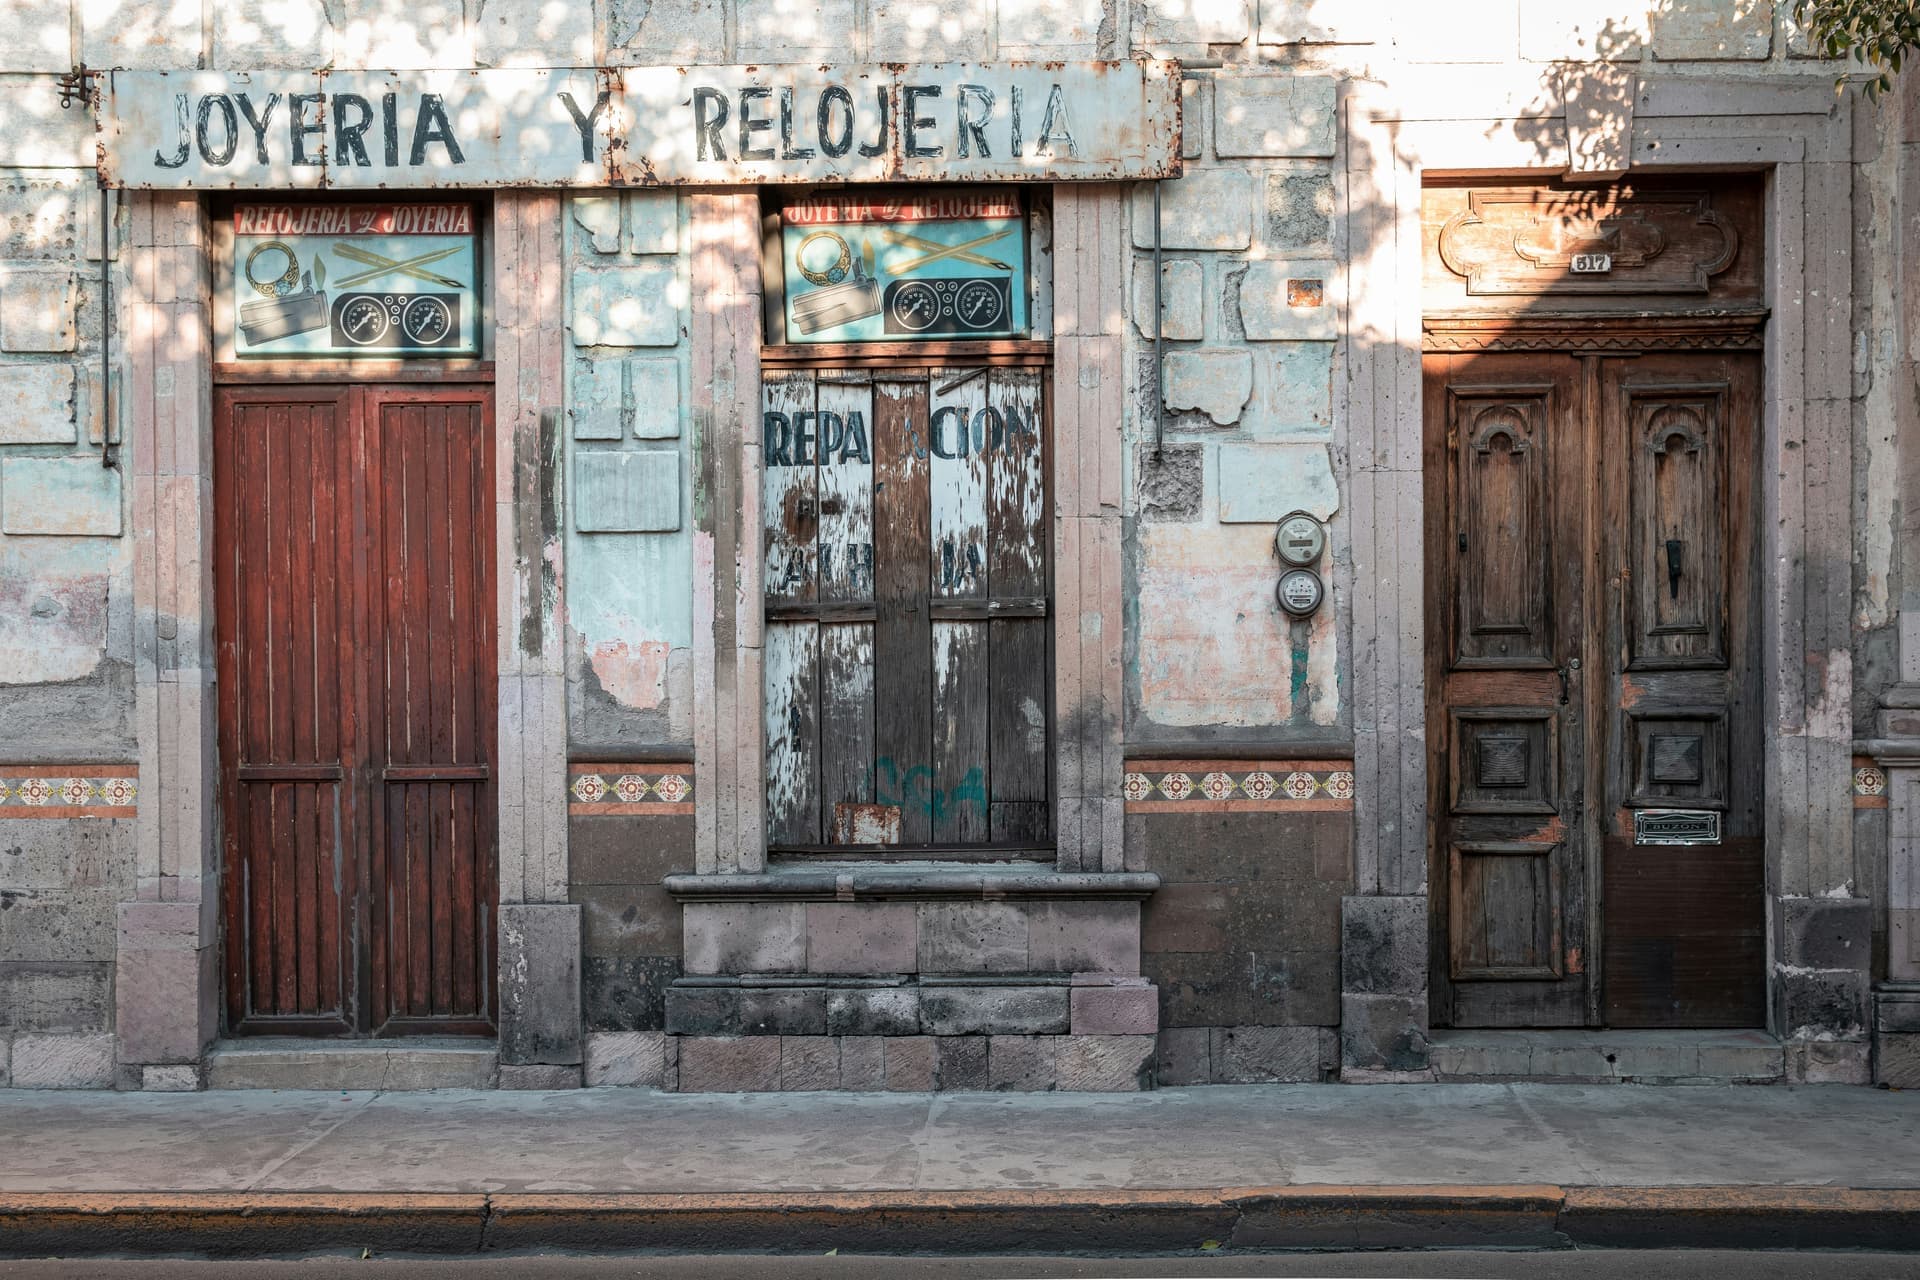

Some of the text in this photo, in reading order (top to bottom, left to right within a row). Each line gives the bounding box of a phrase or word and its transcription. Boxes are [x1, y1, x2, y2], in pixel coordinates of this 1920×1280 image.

[154, 83, 1079, 168] JOYERIA Y RELOJERIA
[238, 206, 351, 235] RELOJERIA
[383, 205, 471, 233] JOYERIA
[788, 198, 874, 222] JOYERIA
[911, 193, 1021, 219] RELOJERIA
[1576, 255, 1606, 271] 517
